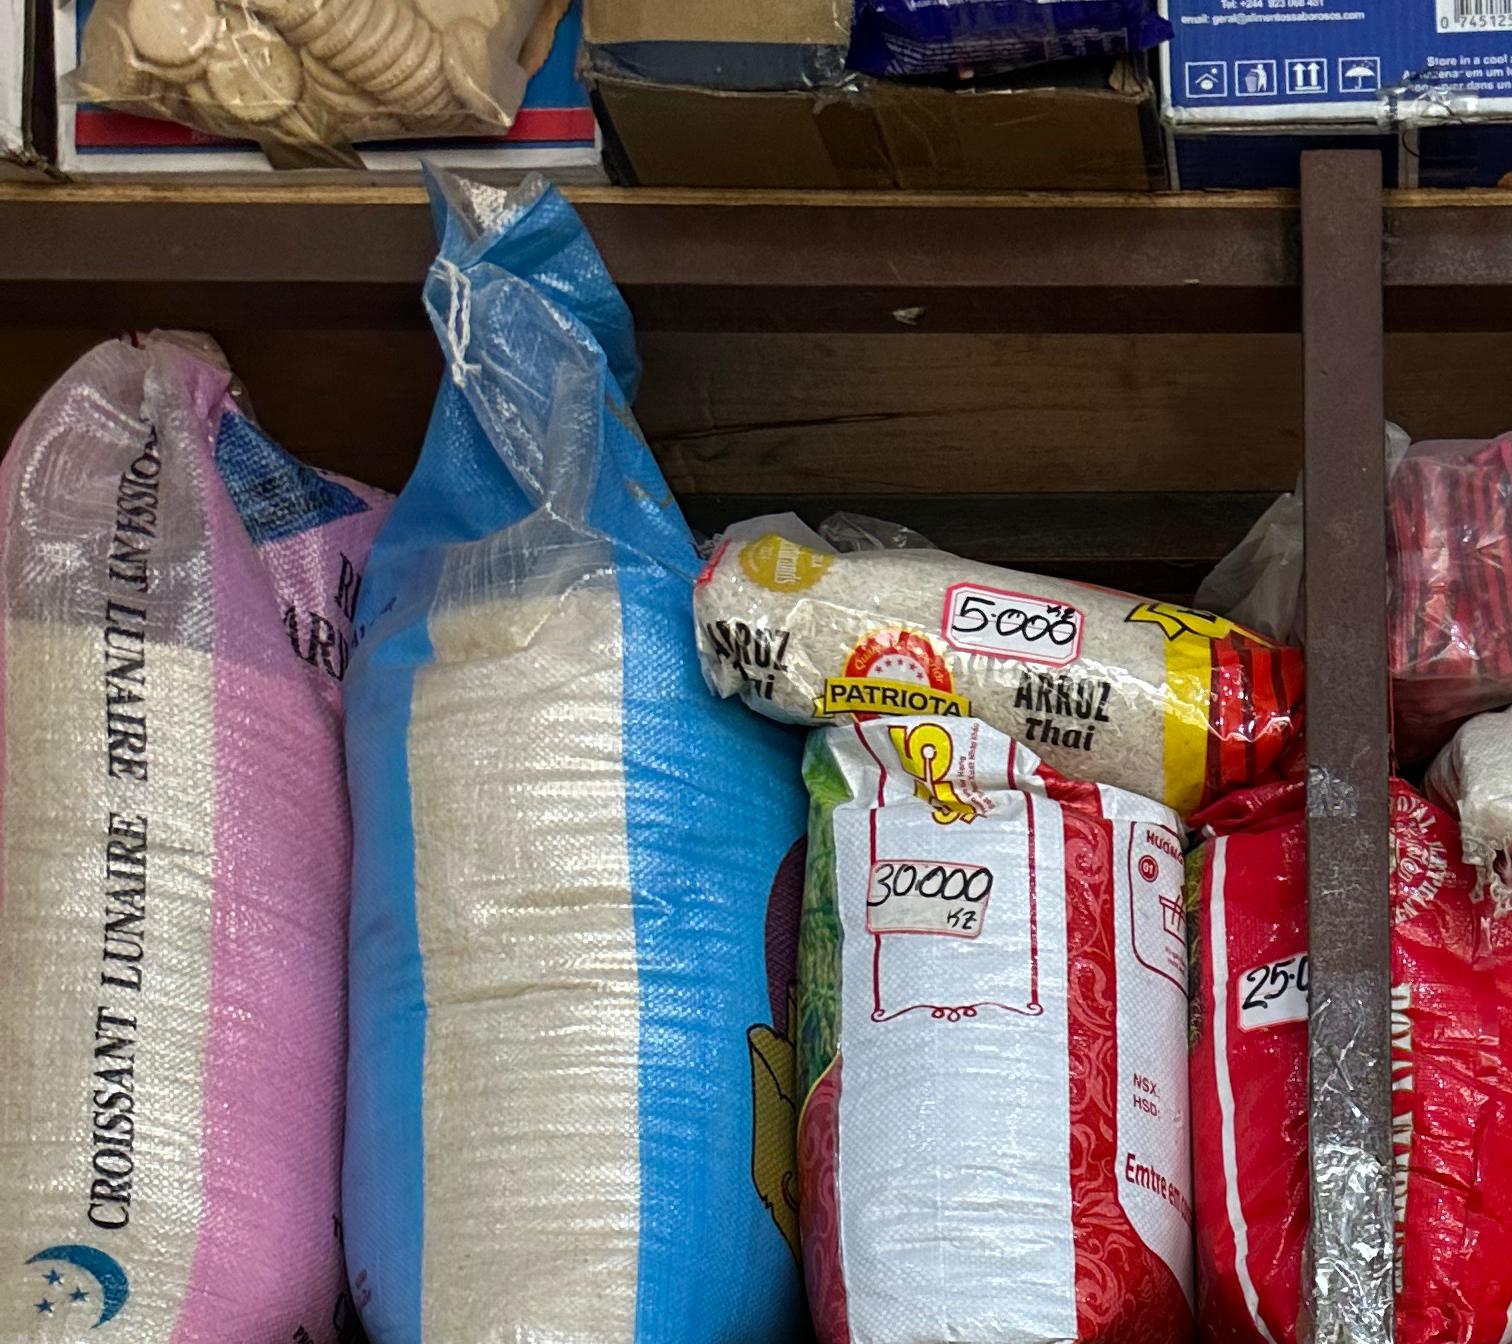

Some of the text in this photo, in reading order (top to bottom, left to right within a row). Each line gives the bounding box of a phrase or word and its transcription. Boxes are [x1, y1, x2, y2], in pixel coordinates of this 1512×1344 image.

[1483, 54, 1508, 65] cool
[951, 596, 1079, 646] 5.000
[829, 683, 965, 718] PATRIOTA
[1013, 671, 1111, 724] ARROZ
[866, 866, 992, 907] 30.000
[88, 814, 149, 1231] CROISSANT LUNAIRE
